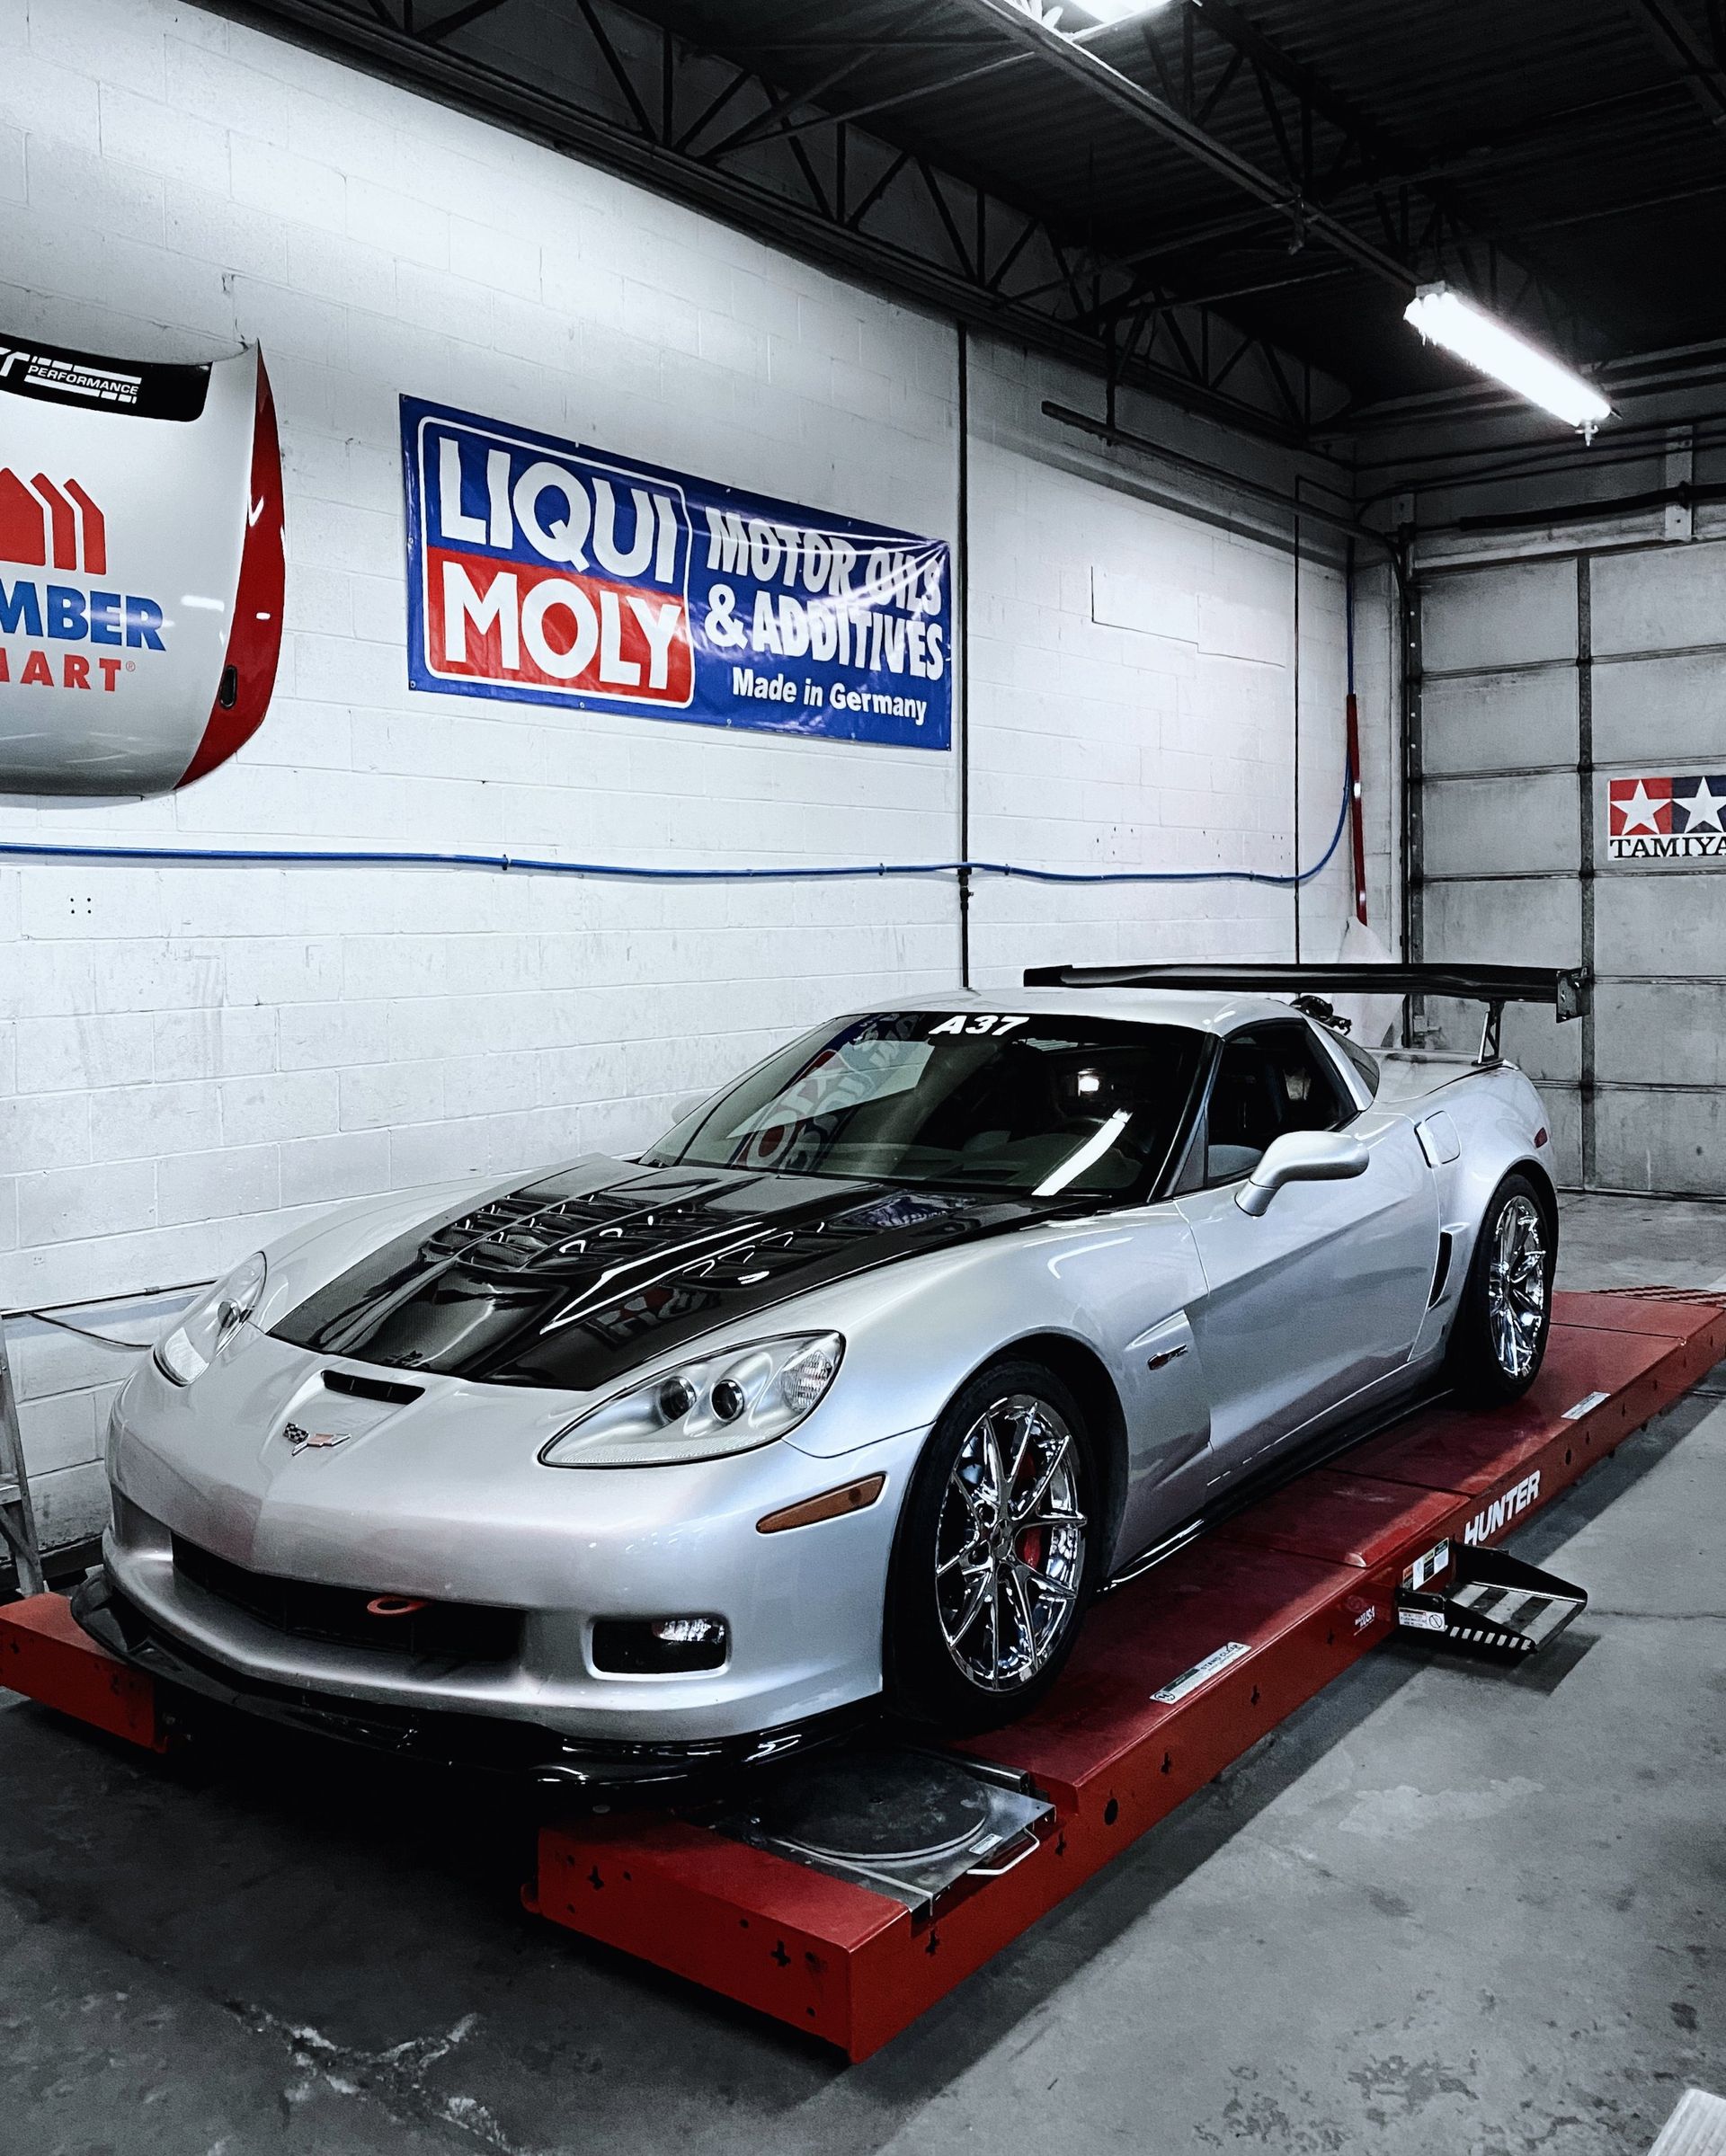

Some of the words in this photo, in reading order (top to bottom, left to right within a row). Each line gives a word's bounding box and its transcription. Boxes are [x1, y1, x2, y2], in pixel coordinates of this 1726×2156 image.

[28, 365, 139, 395] PERFORMANCE
[439, 436, 677, 584] LIQUI
[705, 506, 857, 597] MOTOR
[865, 546, 942, 617] OILS
[441, 561, 682, 691] MOLY
[704, 583, 748, 649] &
[752, 590, 944, 681] ADDITIVES
[732, 667, 797, 703] Made
[803, 678, 823, 707] in
[829, 682, 927, 726] Germany
[1609, 836, 1726, 858] TAMIYA
[928, 1015, 1030, 1035] A37
[1464, 1469, 1541, 1546] HUNTER
